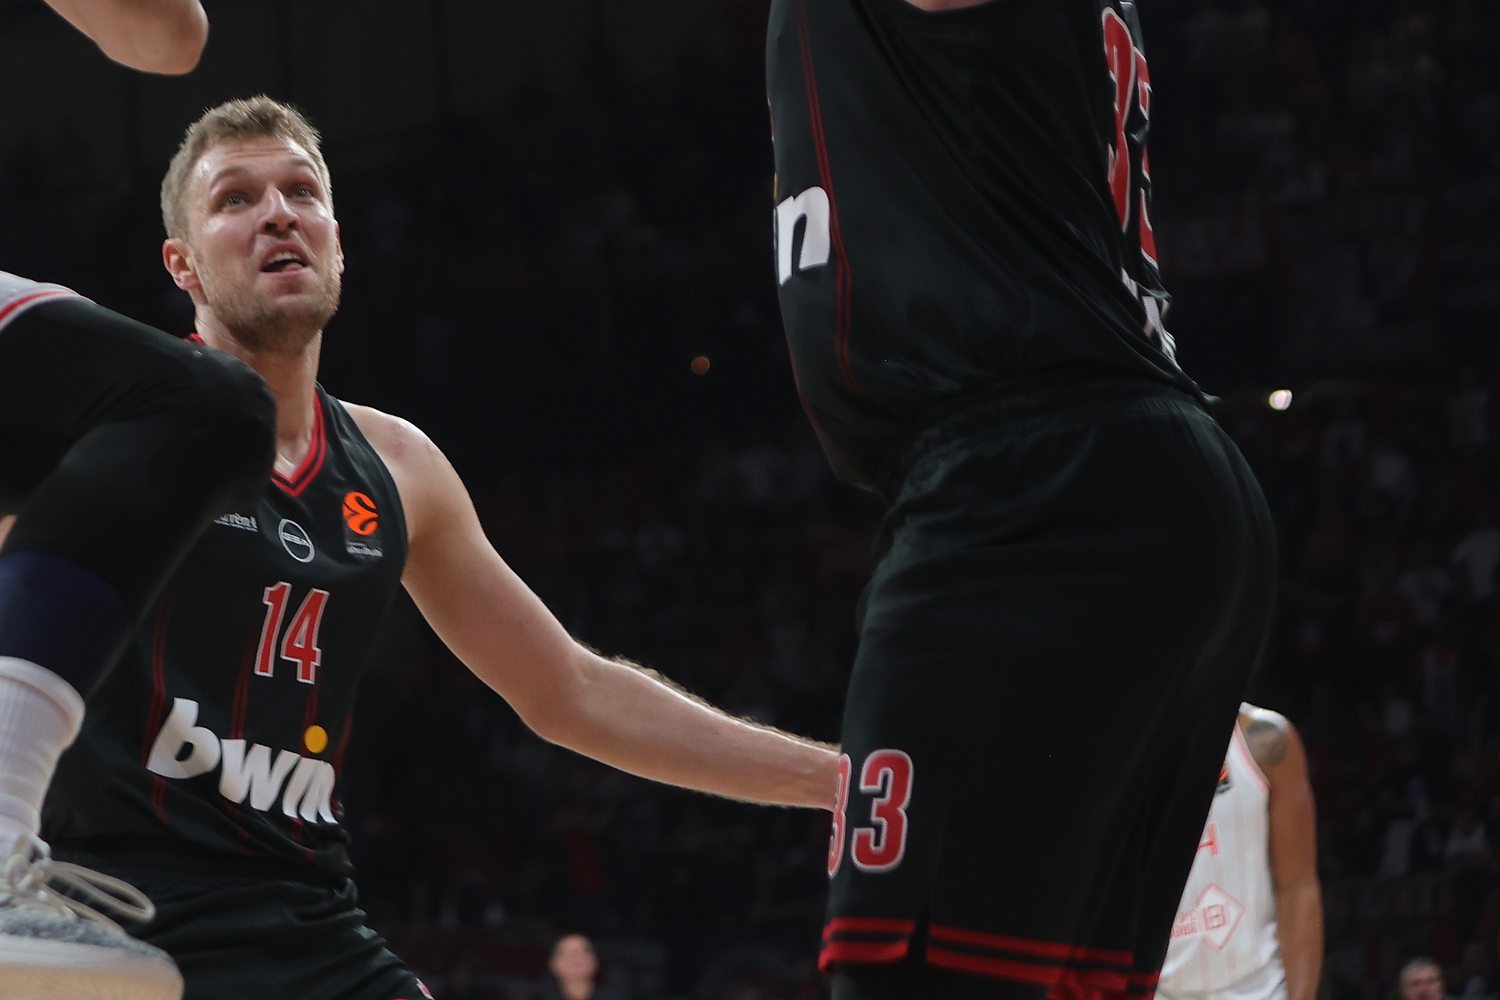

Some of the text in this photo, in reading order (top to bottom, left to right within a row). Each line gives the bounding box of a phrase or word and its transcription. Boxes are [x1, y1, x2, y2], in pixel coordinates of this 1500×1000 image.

[255, 581, 331, 685] 14
[145, 696, 340, 825] bwin
[827, 748, 915, 880] 33
